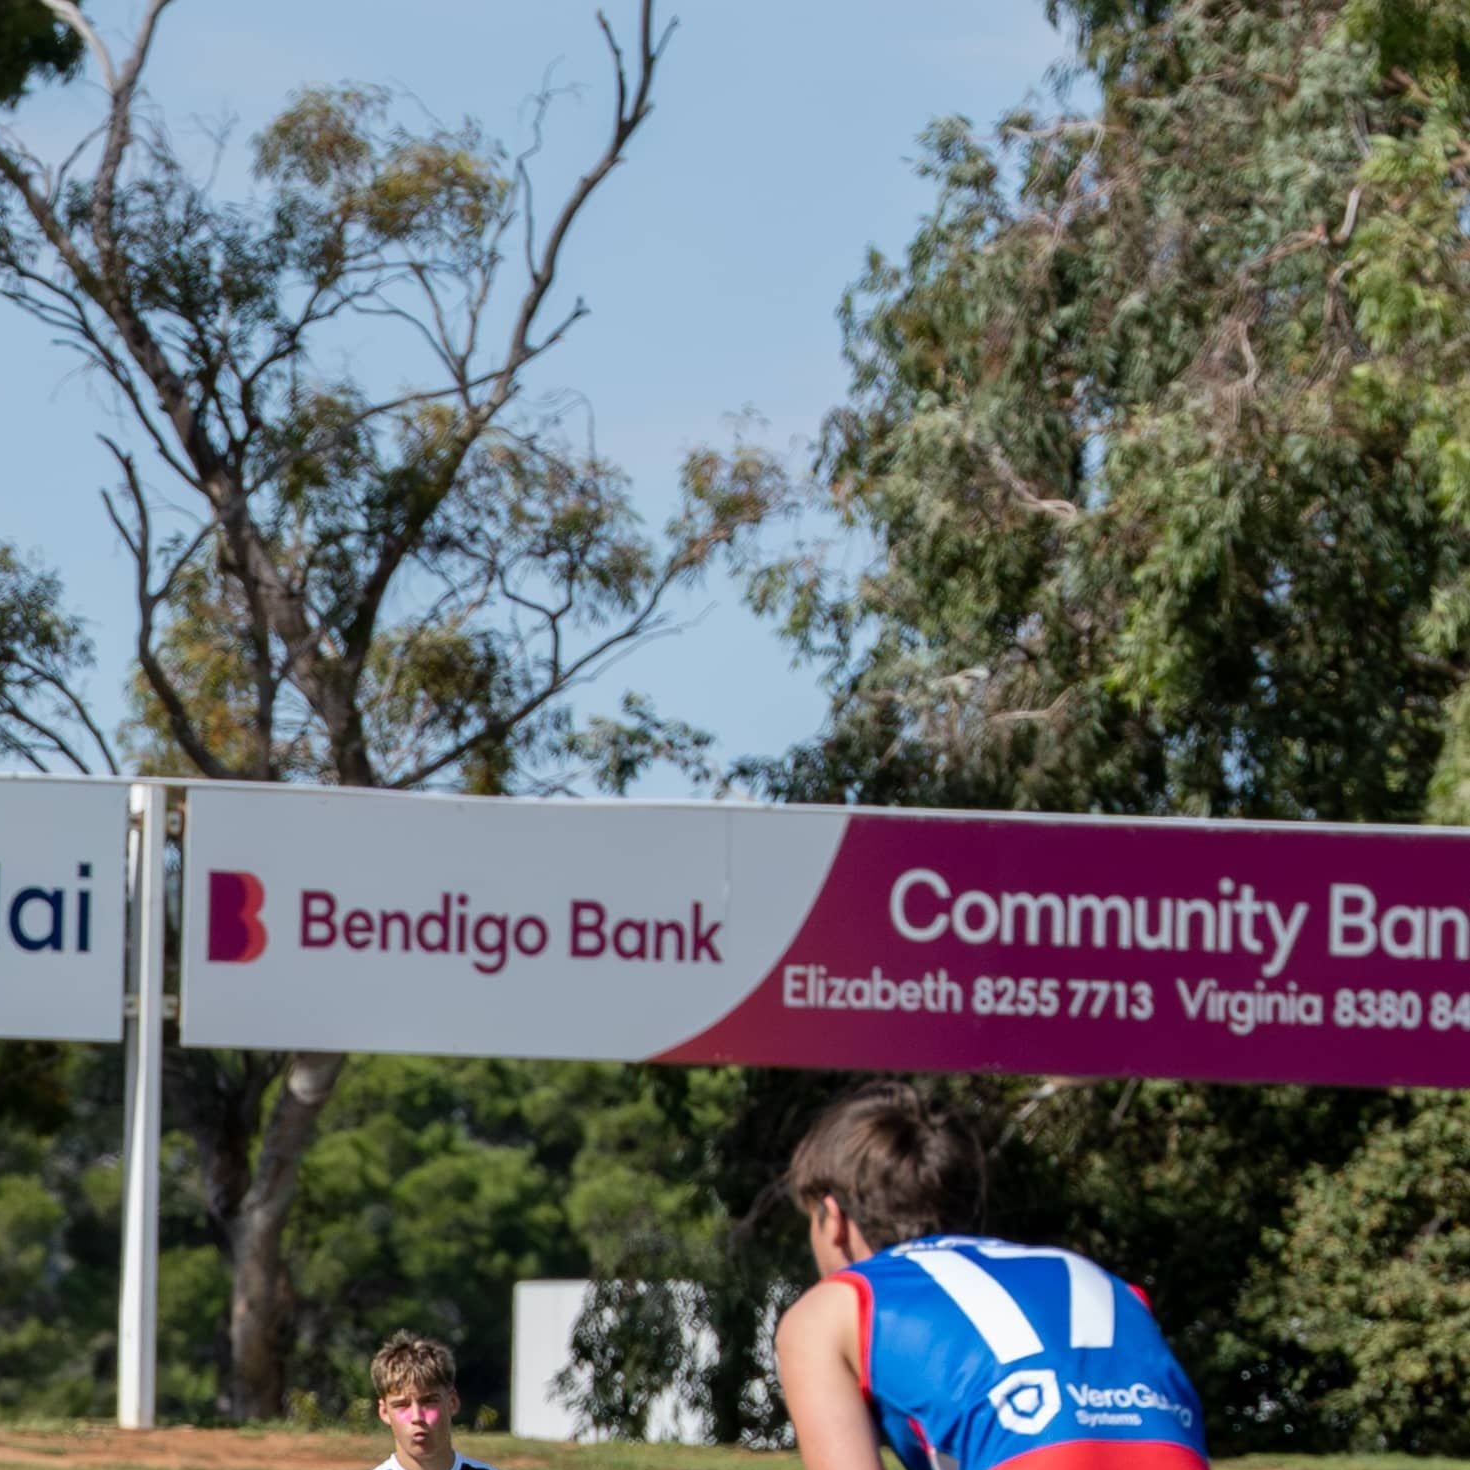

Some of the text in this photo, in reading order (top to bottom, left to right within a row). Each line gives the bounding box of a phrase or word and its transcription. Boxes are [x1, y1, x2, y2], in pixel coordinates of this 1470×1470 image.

[299, 889, 723, 975] Bendigo Bank
[889, 868, 1309, 977] Community
[782, 965, 962, 1013] Elizabeth
[972, 976, 1060, 1017] 8255
[1067, 979, 1154, 1020] 7713
[1176, 978, 1323, 1036] Virginia
[1333, 987, 1424, 1030] 8380
